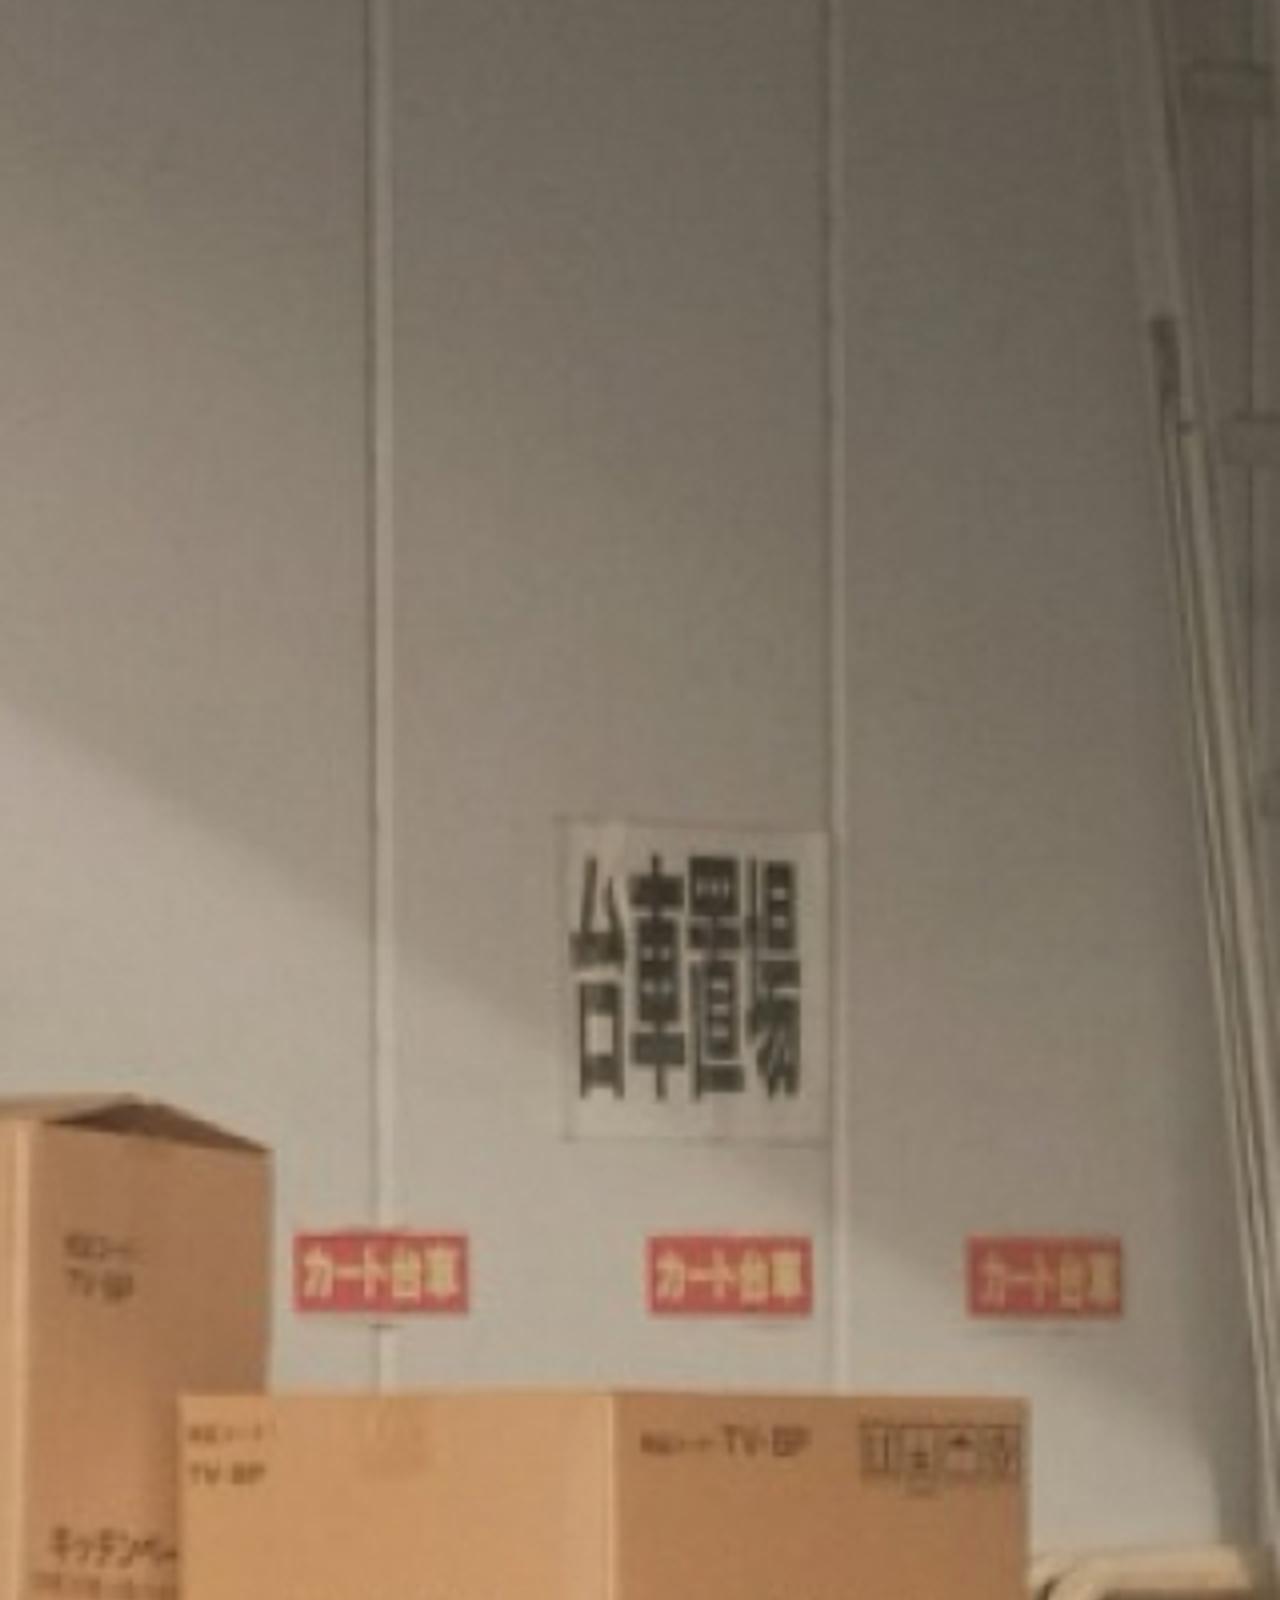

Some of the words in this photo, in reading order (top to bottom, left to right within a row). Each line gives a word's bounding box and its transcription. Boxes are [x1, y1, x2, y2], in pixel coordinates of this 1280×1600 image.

[570, 854, 801, 1100] 台車置場
[302, 1247, 457, 1302] カート台車
[654, 1249, 802, 1303] カート台車
[981, 1250, 1117, 1305] カート台車
